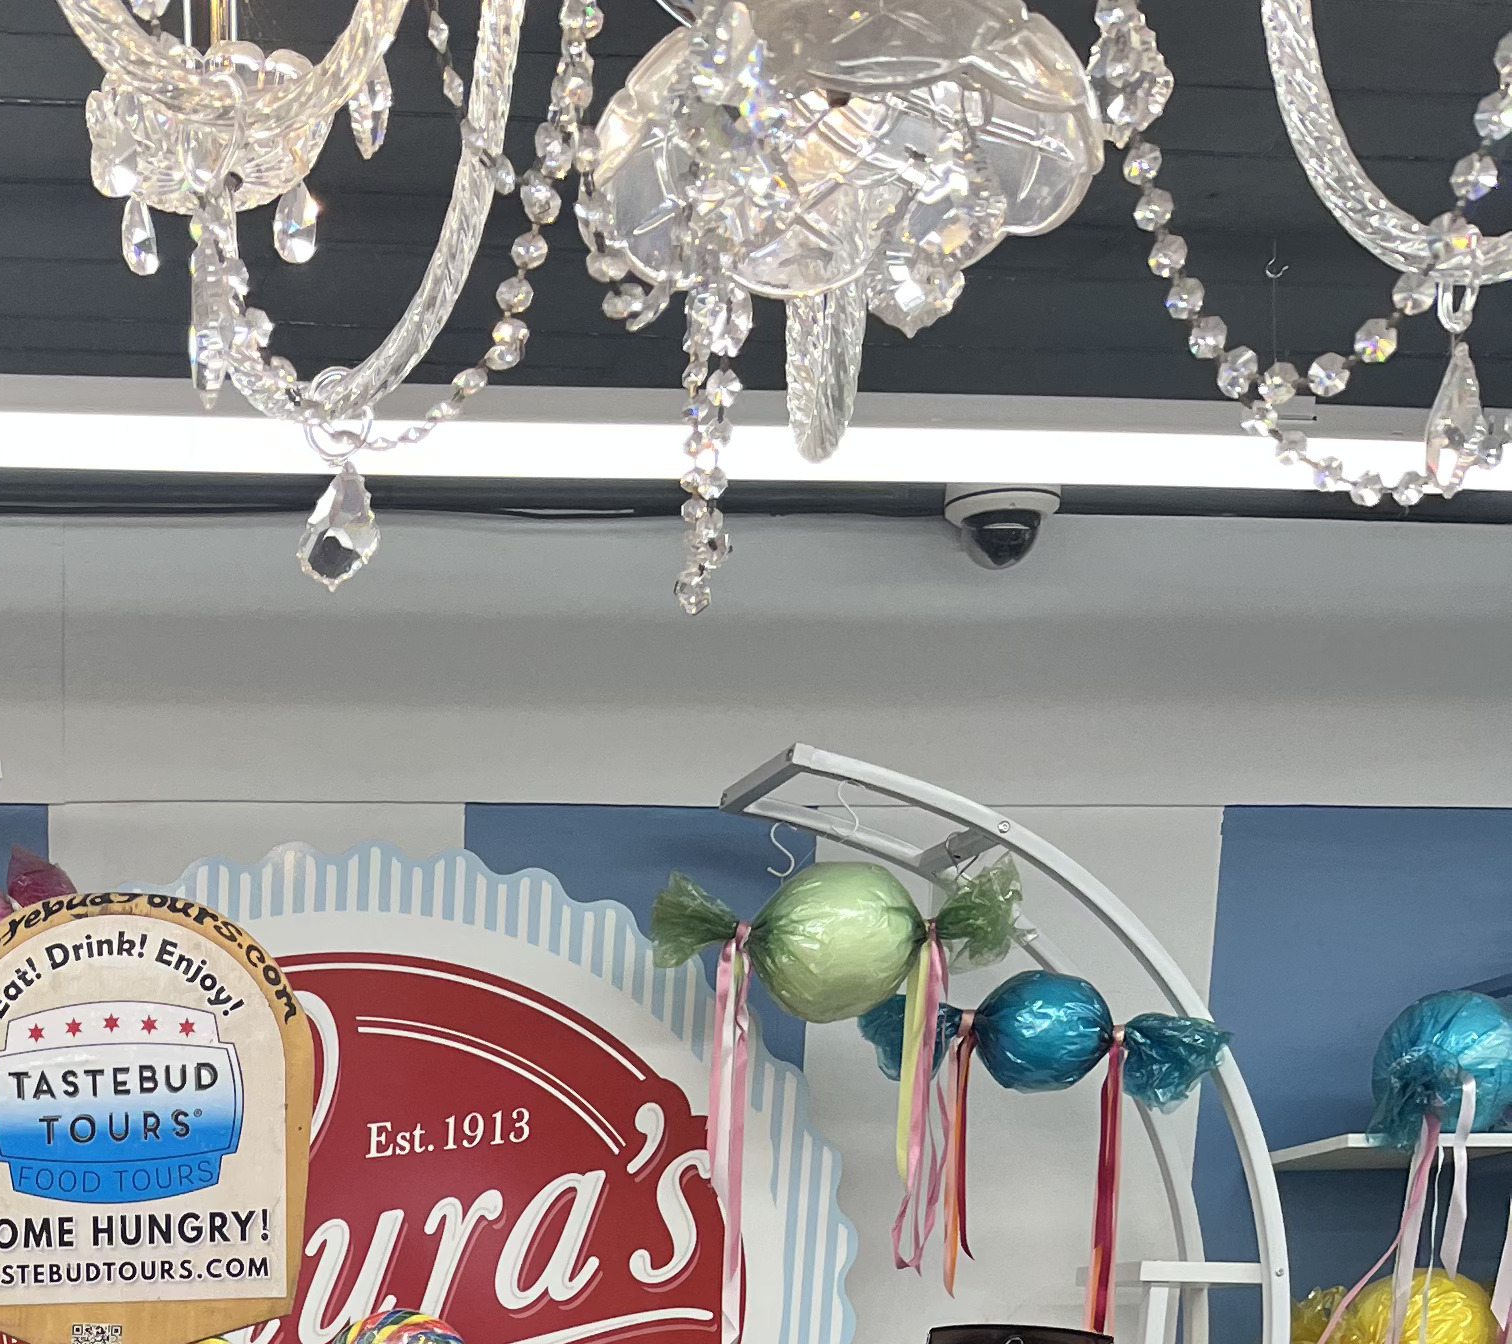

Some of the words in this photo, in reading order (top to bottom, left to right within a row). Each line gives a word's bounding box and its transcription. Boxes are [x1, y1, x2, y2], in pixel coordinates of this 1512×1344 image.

[45, 931, 148, 971] Drink!
[155, 938, 246, 1017] Enjoy!
[8, 1062, 219, 1101] TASTEBUD
[365, 1120, 434, 1158] Est.
[443, 1107, 531, 1150] 1913
[17, 1166, 101, 1193] FOOD
[114, 1160, 215, 1192] TOURS
[92, 1208, 271, 1247] HUNGRY!
